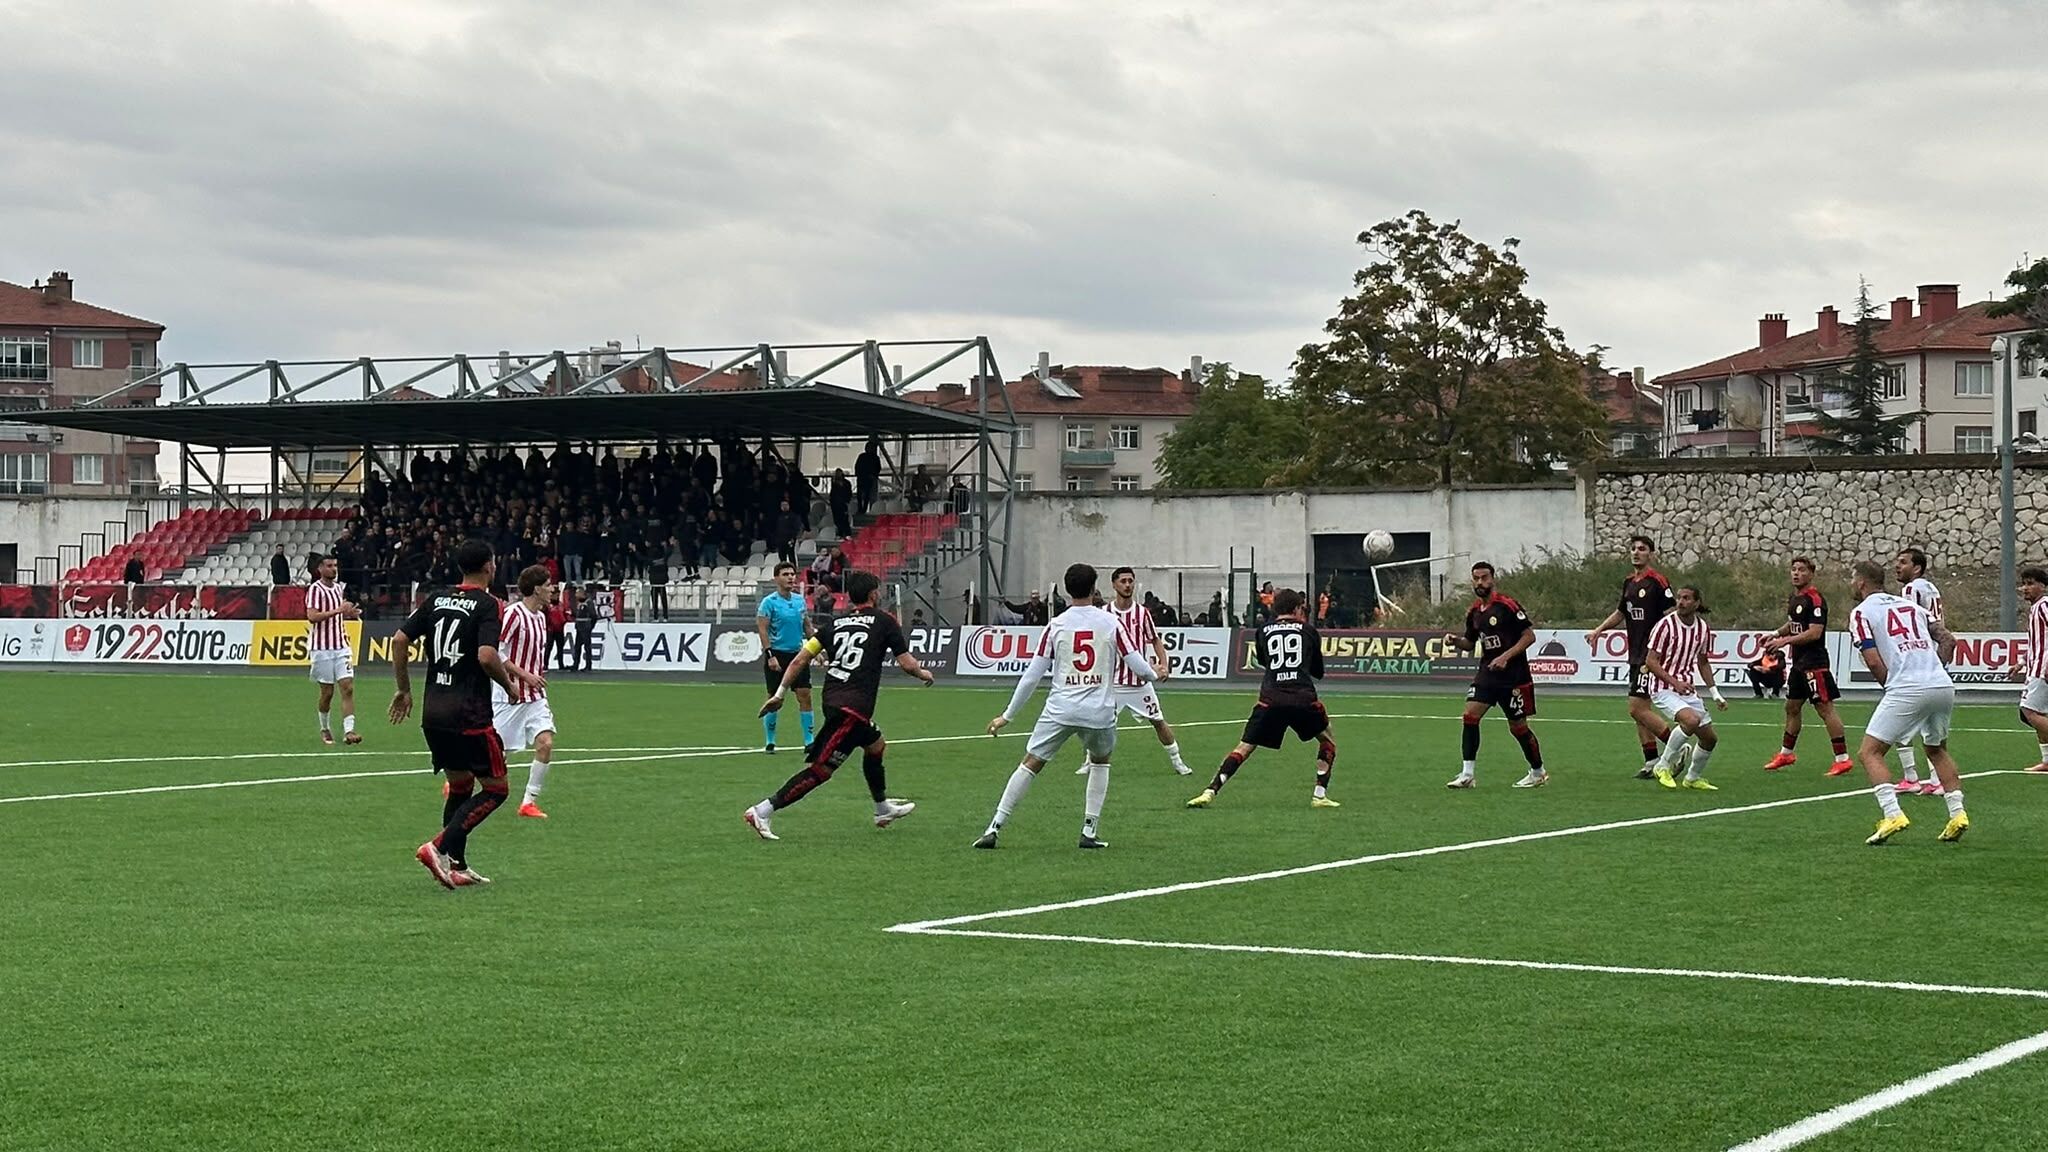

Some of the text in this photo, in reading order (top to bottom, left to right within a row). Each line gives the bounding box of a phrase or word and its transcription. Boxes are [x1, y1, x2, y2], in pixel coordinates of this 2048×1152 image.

[434, 596, 477, 611] EUROPEN
[1887, 606, 1920, 640] 47
[260, 635, 310, 661] NES
[434, 617, 465, 667] 14
[621, 632, 701, 663] SAK
[1072, 630, 1096, 672] 5
[1267, 634, 1303, 670] 99
[1321, 635, 1419, 658] USTAFA
[1353, 658, 1434, 675] TARIM
[1065, 673, 1102, 686] ALİ CAN
[1637, 673, 1649, 687] 16
[1146, 703, 1159, 716] 22
